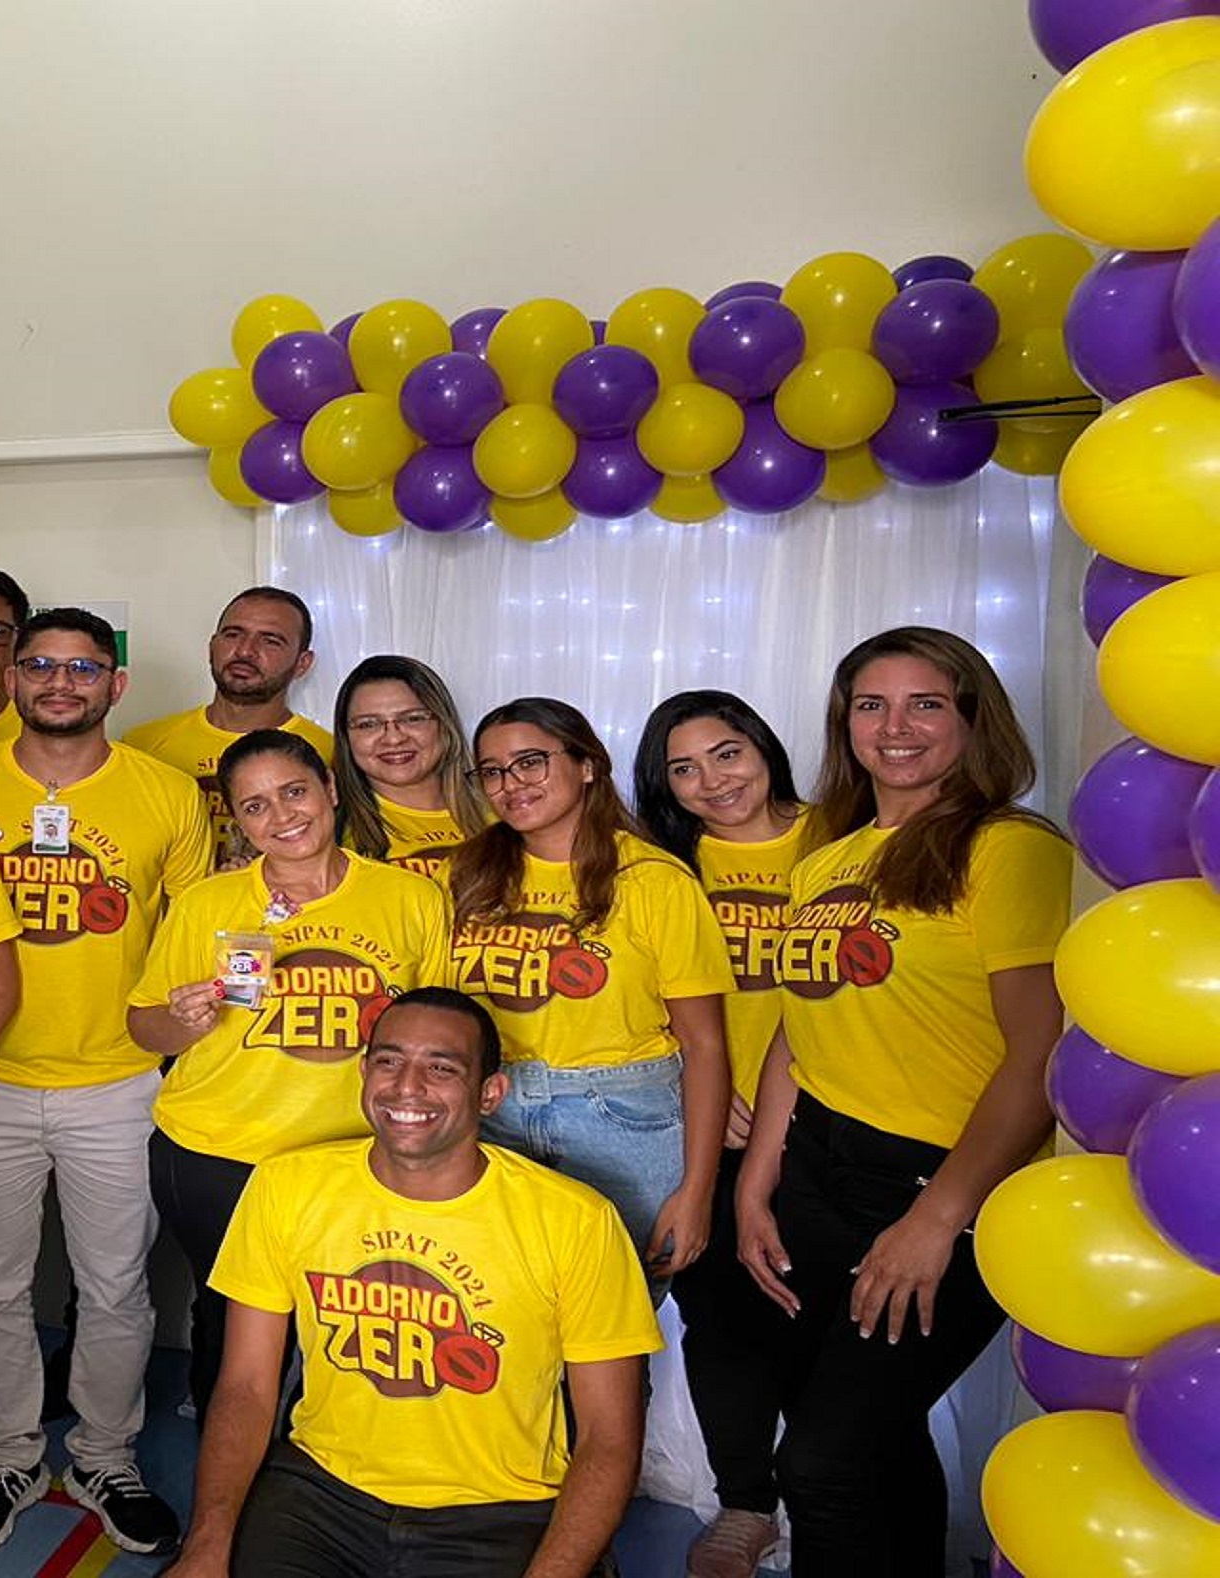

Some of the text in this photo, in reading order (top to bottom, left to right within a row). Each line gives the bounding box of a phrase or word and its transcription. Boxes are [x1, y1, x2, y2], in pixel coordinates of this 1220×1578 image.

[83, 826, 126, 867] 2024
[415, 830, 460, 846] SIPA
[714, 871, 780, 887] SIPAT
[7, 882, 129, 934] ERO
[282, 925, 402, 972] SIPAT 2024
[454, 922, 571, 950] ADORNO
[264, 966, 376, 995] DORNO
[361, 1229, 494, 1311] SIPAT 2024
[320, 1275, 457, 1329] ADORNO
